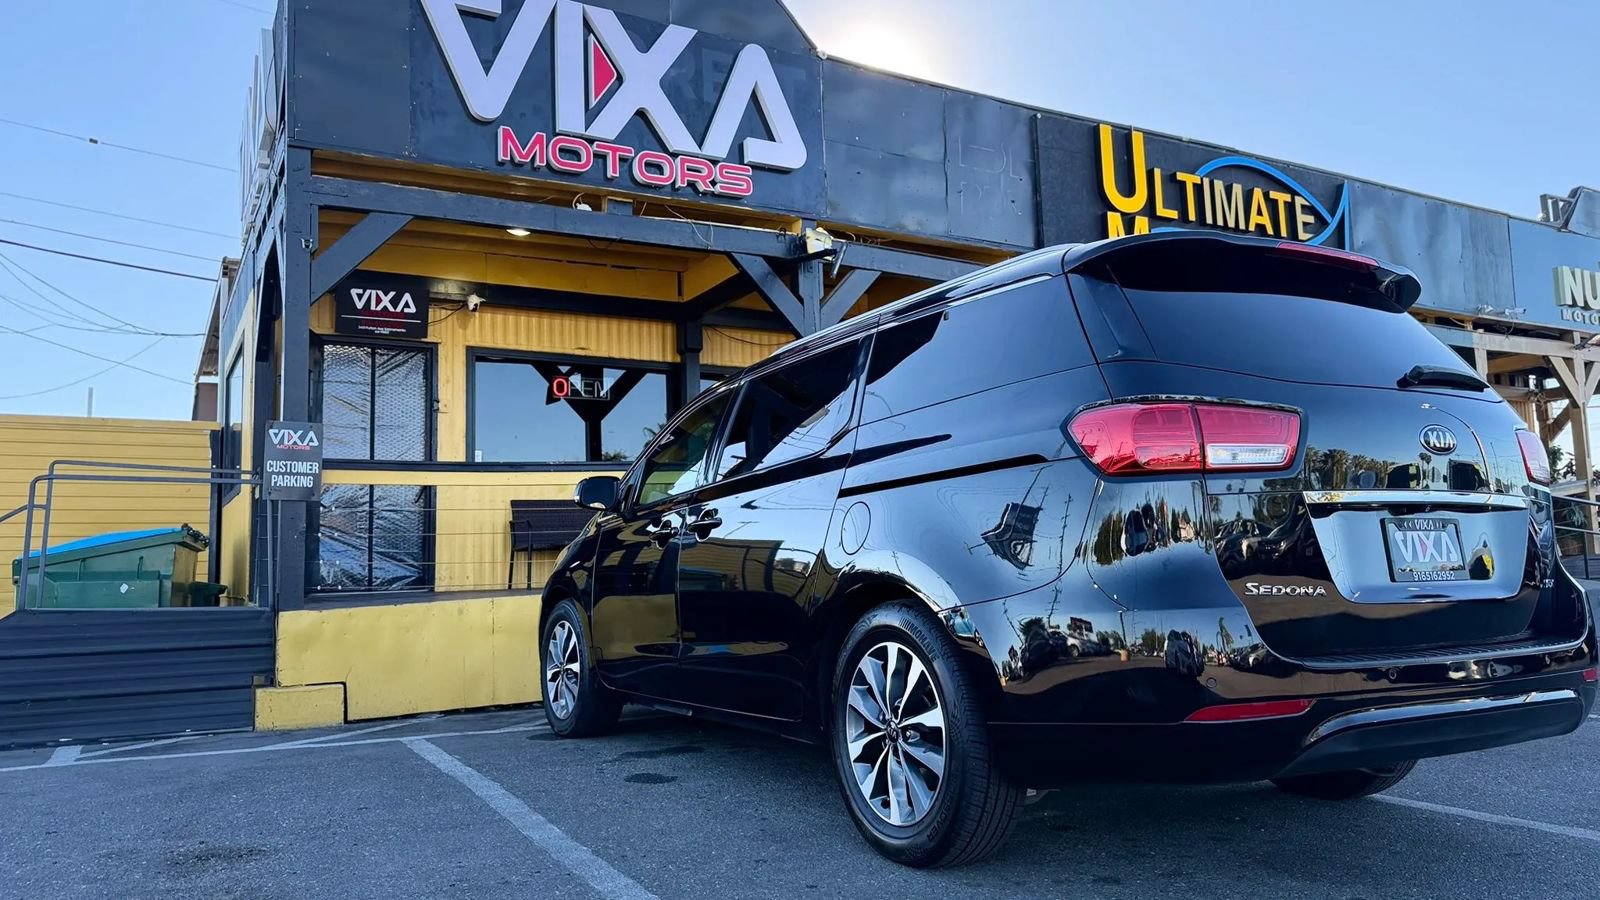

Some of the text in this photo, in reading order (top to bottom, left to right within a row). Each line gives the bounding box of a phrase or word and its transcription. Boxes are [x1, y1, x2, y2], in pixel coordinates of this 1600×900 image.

[422, 0, 807, 170] VIXA
[498, 125, 754, 198] MOTORS
[1099, 124, 1316, 241] ULTIMATE
[350, 288, 417, 313] VIXA
[268, 428, 319, 447] VIXA
[1425, 430, 1457, 449] KIA
[266, 460, 319, 474] CUSTOMER
[271, 475, 314, 488] PARKING
[1414, 519, 1435, 530] VIXA
[1394, 531, 1459, 563] VIXA
[1412, 571, 1456, 581] 9165162952
[1244, 582, 1328, 597] SEDONA
